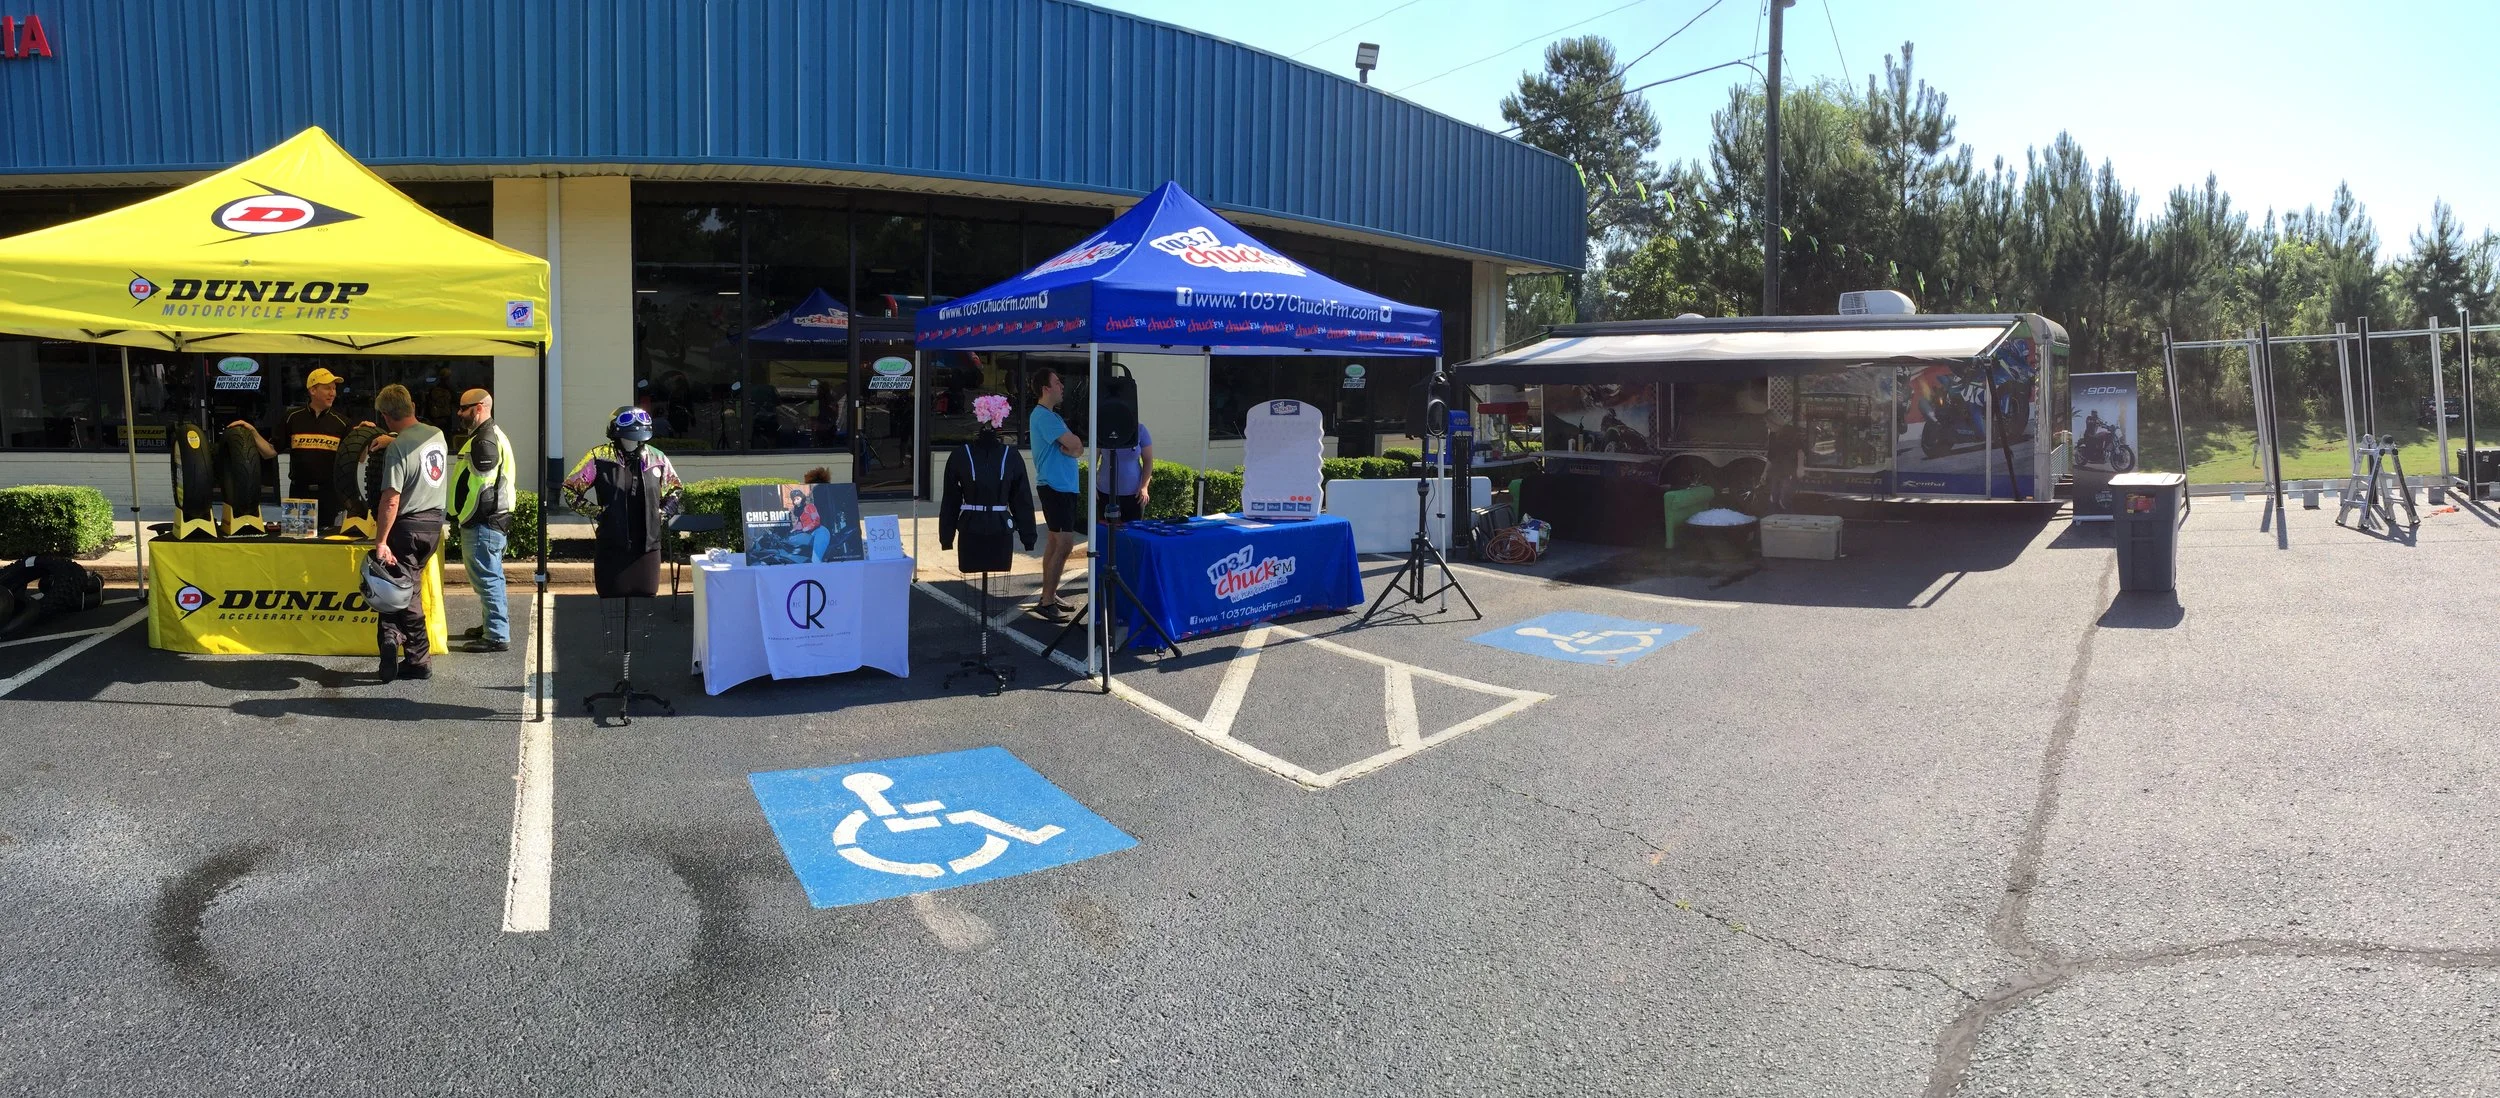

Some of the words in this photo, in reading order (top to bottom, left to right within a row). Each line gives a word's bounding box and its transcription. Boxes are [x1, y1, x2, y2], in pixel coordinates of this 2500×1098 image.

[1157, 231, 1214, 251] 103.7
[165, 279, 369, 304] DUNLOP
[161, 303, 285, 319] MOTORCYCLE
[295, 307, 350, 320] TIRES
[1195, 291, 1379, 322] www.1037ChuckFm.com
[1106, 316, 1146, 331] chuckFM
[1148, 317, 1185, 332] chuckFM
[1188, 318, 1224, 333] chuckFM
[216, 381, 259, 389] MOTORSPORTS
[870, 381, 911, 389] MOTORSPORTS
[136, 439, 166, 447] DEALER
[298, 437, 339, 446] DUNLOP
[746, 511, 769, 523] CHIC
[769, 510, 791, 521] RIOT
[870, 527, 895, 543] $20
[1209, 549, 1252, 580] 103.7
[218, 590, 378, 612] DUNLO
[218, 612, 302, 621] ACCELERATE
[311, 614, 344, 622] YOUR
